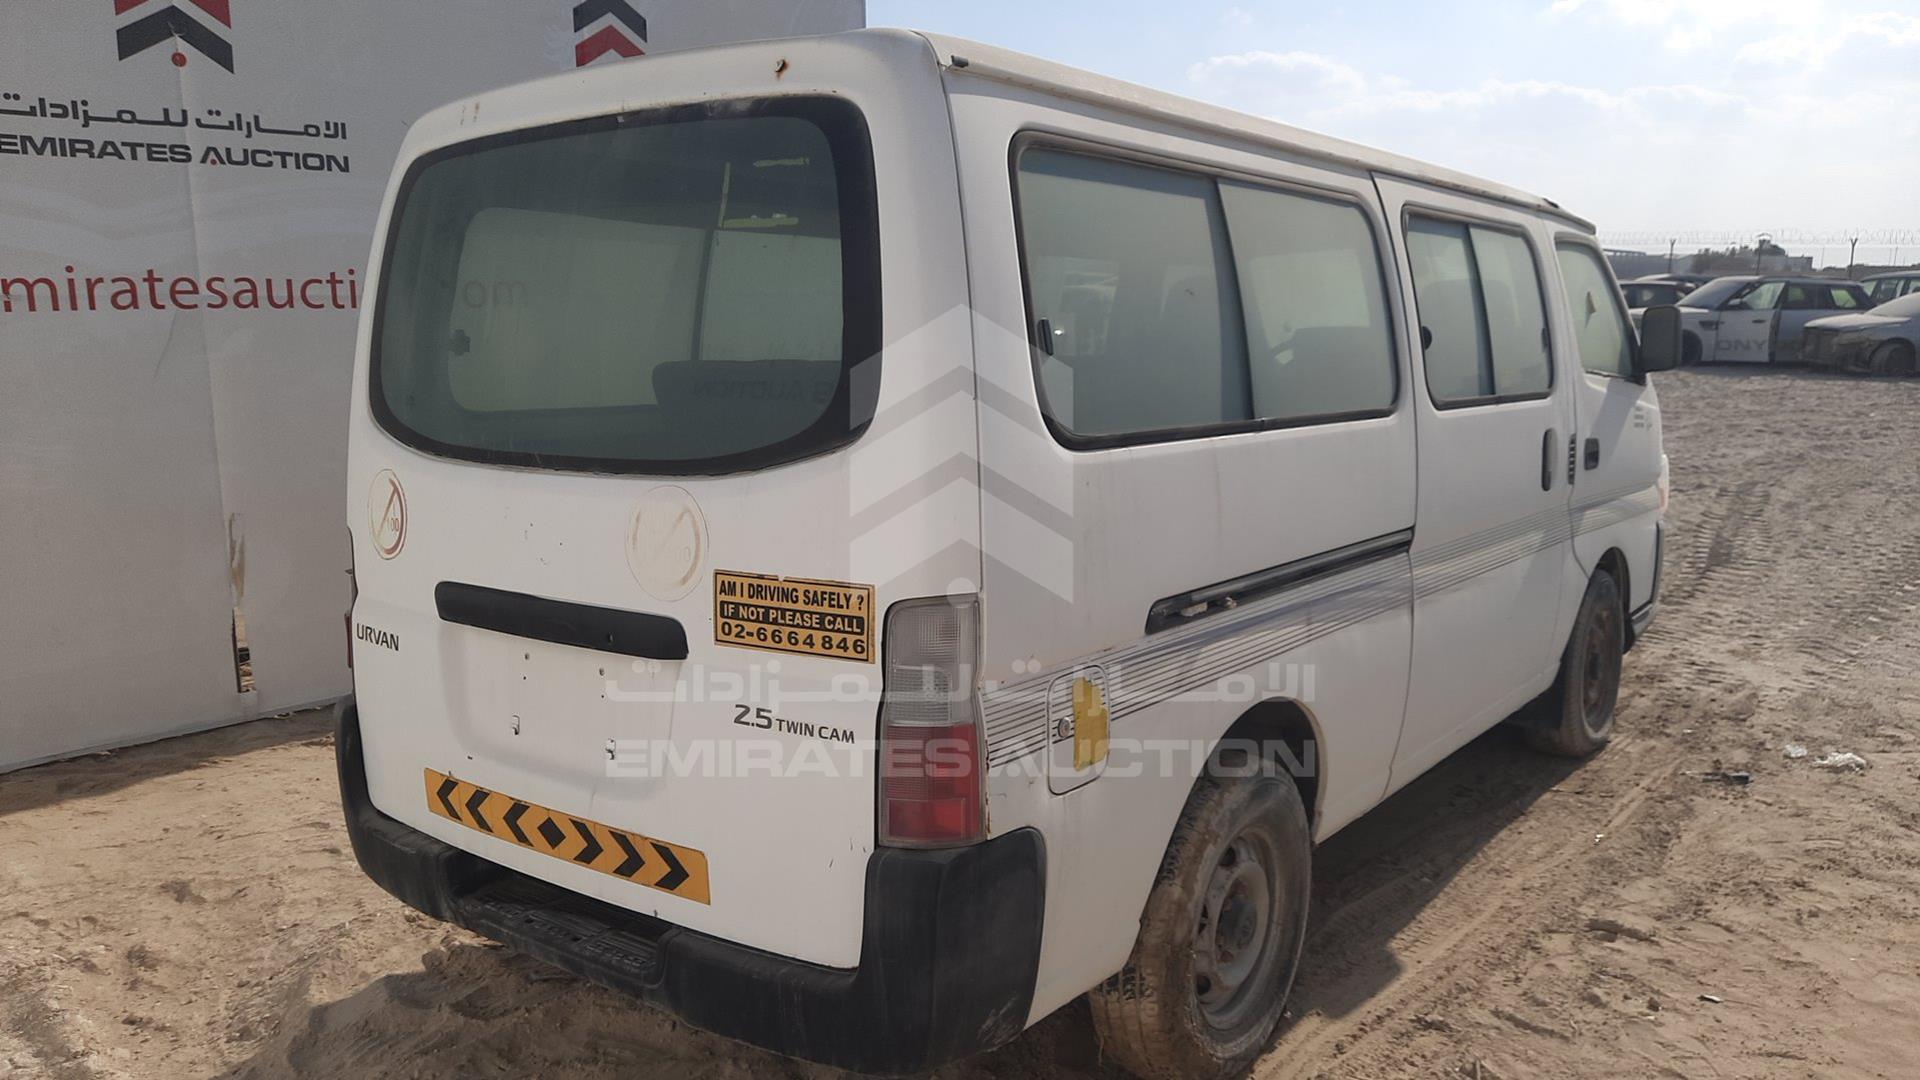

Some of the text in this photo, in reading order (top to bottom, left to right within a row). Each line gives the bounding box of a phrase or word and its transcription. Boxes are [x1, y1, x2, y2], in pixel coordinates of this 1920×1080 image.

[0, 133, 350, 174] EMIRATES AUCTION
[719, 580, 737, 597] AM
[740, 582, 744, 598] I
[747, 584, 799, 605] DRIVING
[803, 589, 853, 610] SAFELY
[723, 604, 862, 632] IF NOT PLEASE CALL
[356, 622, 400, 651] URVAN
[733, 703, 855, 744] 2.5 TWIN CAM
